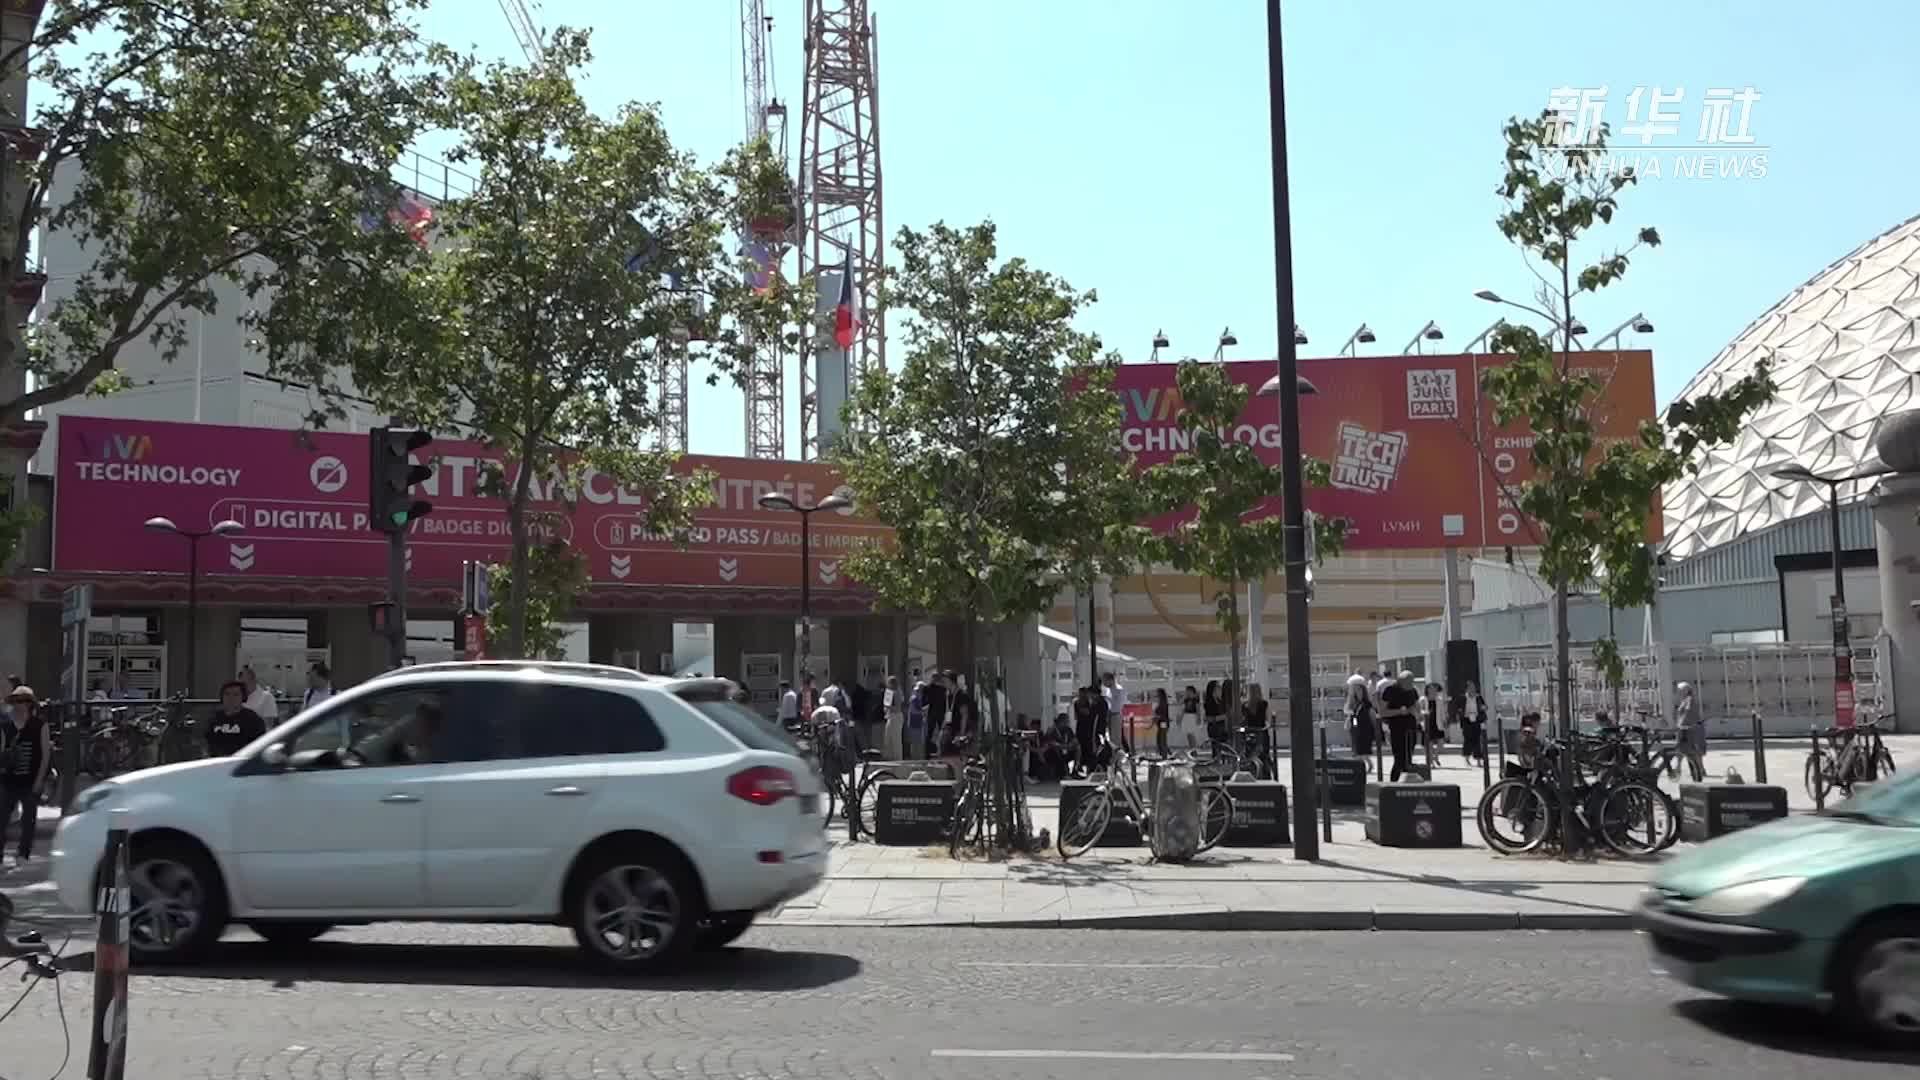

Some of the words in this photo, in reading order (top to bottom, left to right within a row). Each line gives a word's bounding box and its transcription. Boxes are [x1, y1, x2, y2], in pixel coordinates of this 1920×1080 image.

[1412, 387, 1452, 399] JUNE
[1412, 402, 1454, 415] PARIS
[1342, 434, 1400, 466] TECH
[75, 462, 241, 488] TECHNOLOGY
[1335, 463, 1394, 491] TRUST
[254, 509, 347, 532] DIGITAL
[423, 517, 483, 535] BADGE
[1382, 519, 1421, 533] LVMH
[716, 527, 760, 545] PASS
